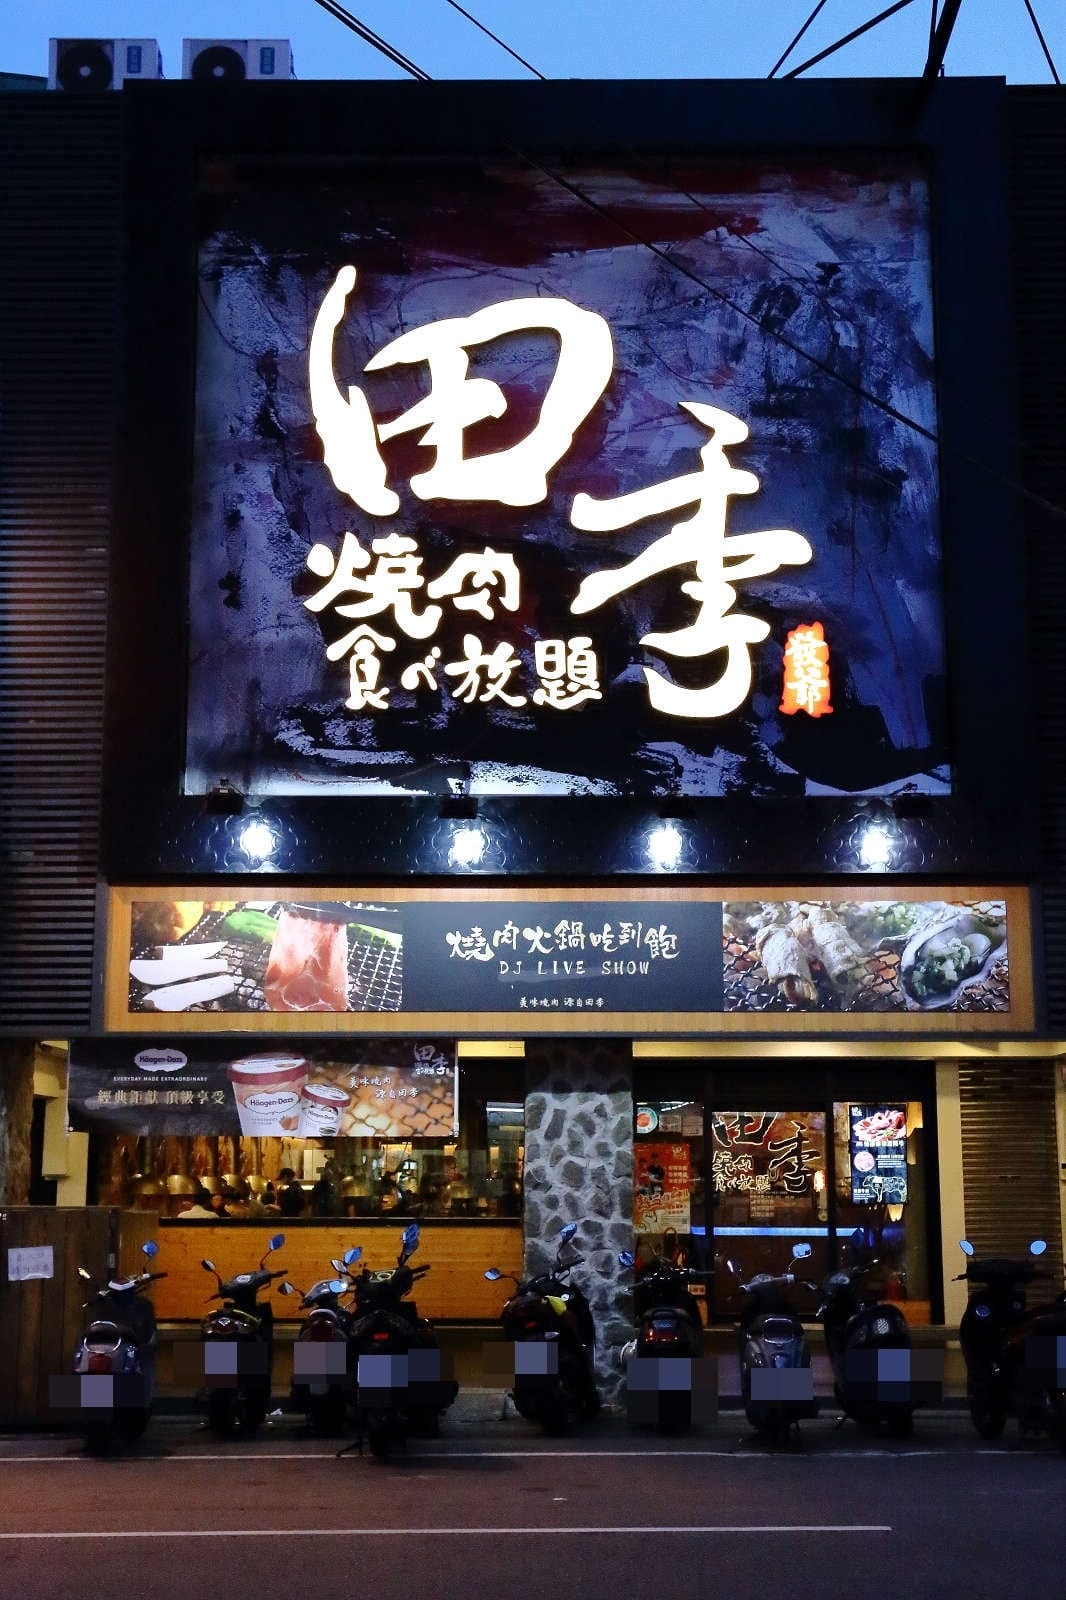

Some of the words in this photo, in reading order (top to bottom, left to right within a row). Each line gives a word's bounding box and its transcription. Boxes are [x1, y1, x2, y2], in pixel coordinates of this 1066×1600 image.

[326, 623, 603, 710] 食べ放題
[445, 919, 681, 961] 燒肉火鍋吃到飽
[499, 960, 522, 975] DJ
[537, 960, 586, 975] LIVE
[602, 960, 650, 975] SHOW
